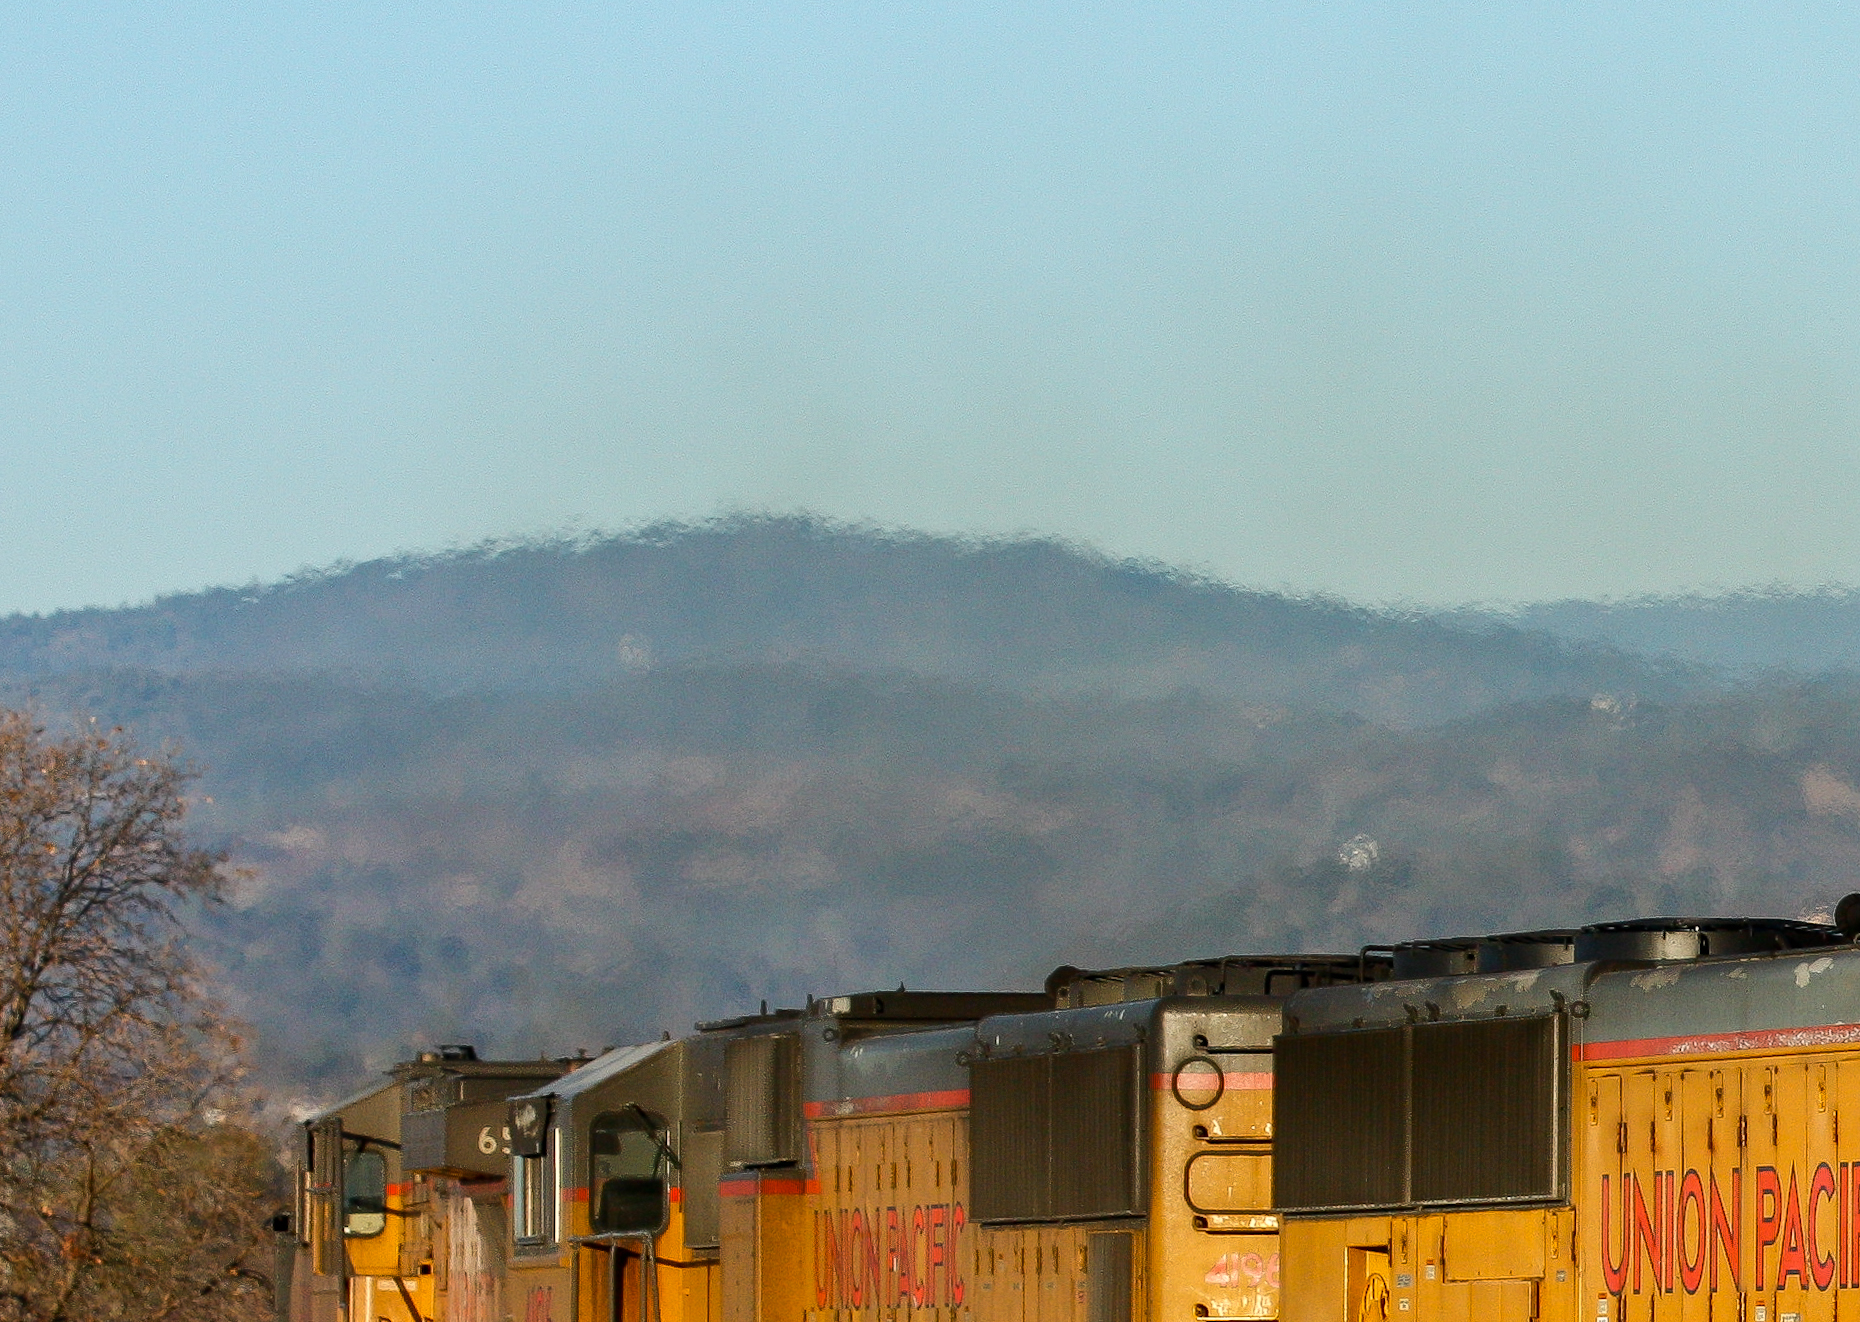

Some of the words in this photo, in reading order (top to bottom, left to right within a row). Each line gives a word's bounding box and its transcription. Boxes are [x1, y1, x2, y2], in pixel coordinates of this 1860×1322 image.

[814, 1202, 880, 1311] UNION
[886, 1201, 964, 1310] PACIFIC
[1205, 1252, 1280, 1288] 4196
[1601, 1167, 1741, 1297] UNION
